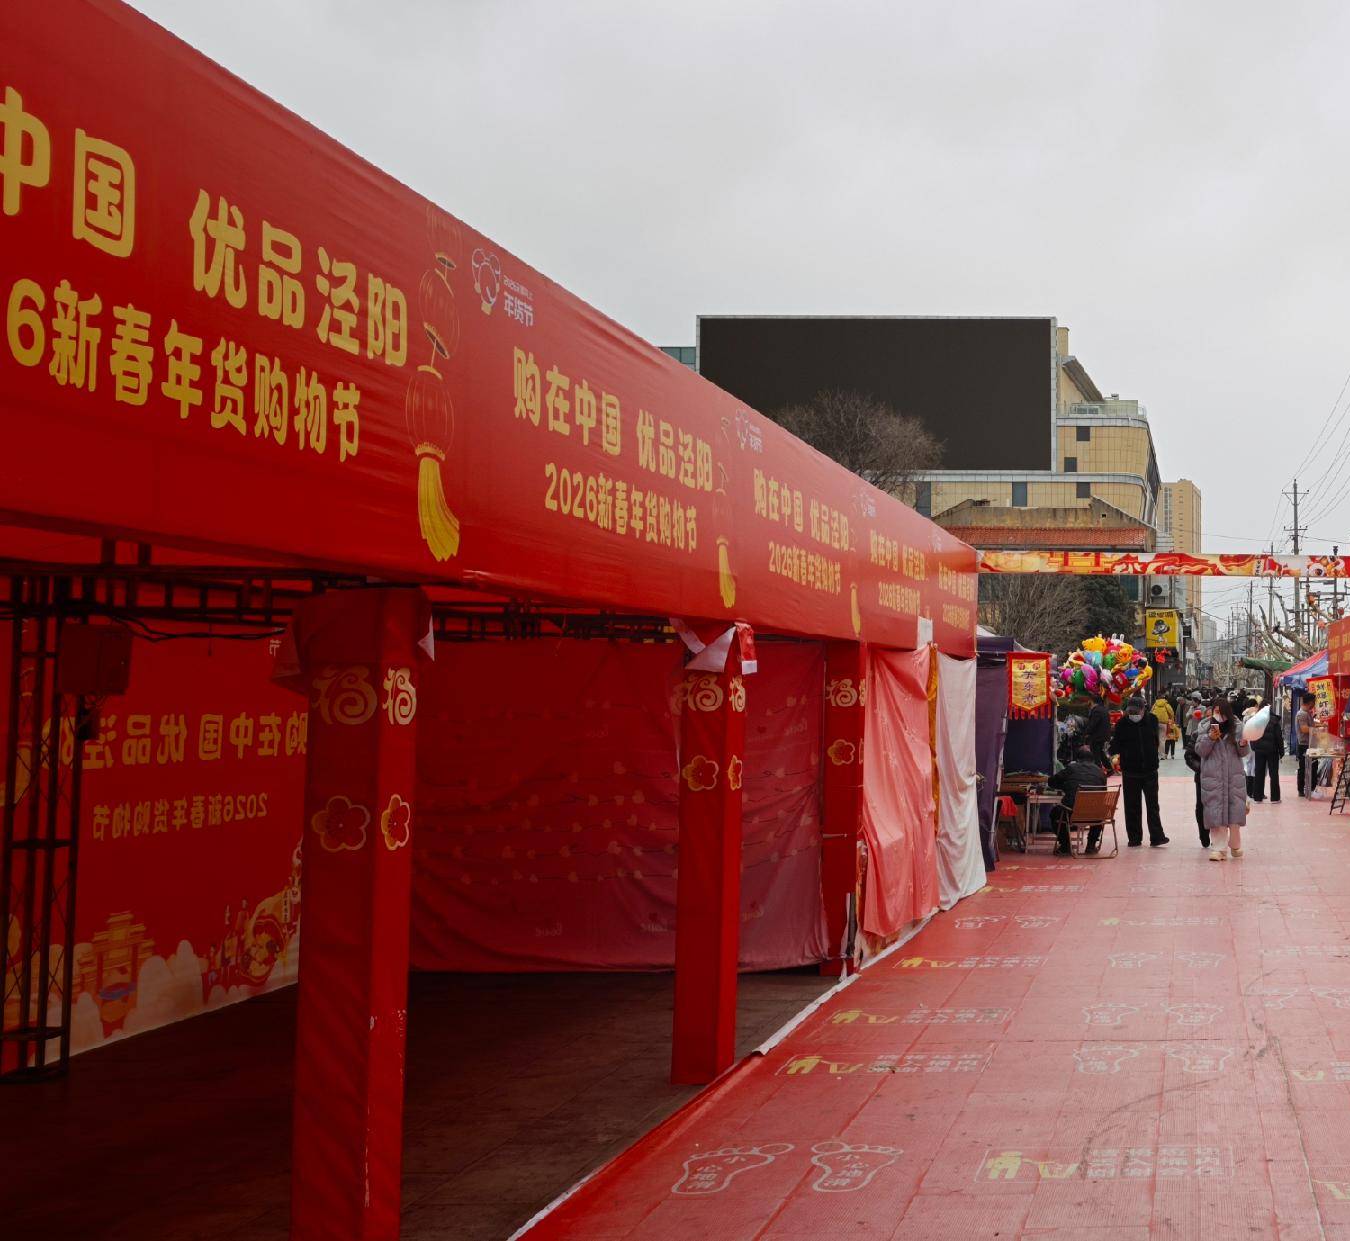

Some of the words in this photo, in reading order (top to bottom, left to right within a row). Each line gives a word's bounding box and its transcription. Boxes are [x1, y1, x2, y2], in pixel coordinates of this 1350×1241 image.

[0, 87, 136, 257] 中国
[189, 189, 408, 367] 优品泾阳
[7, 279, 361, 462] 6新春年货购物节
[513, 346, 621, 456] 购在中国
[636, 409, 712, 493] 优品泾阳
[545, 463, 698, 553] 2026新春年货购物节
[753, 468, 804, 533] 购在中国
